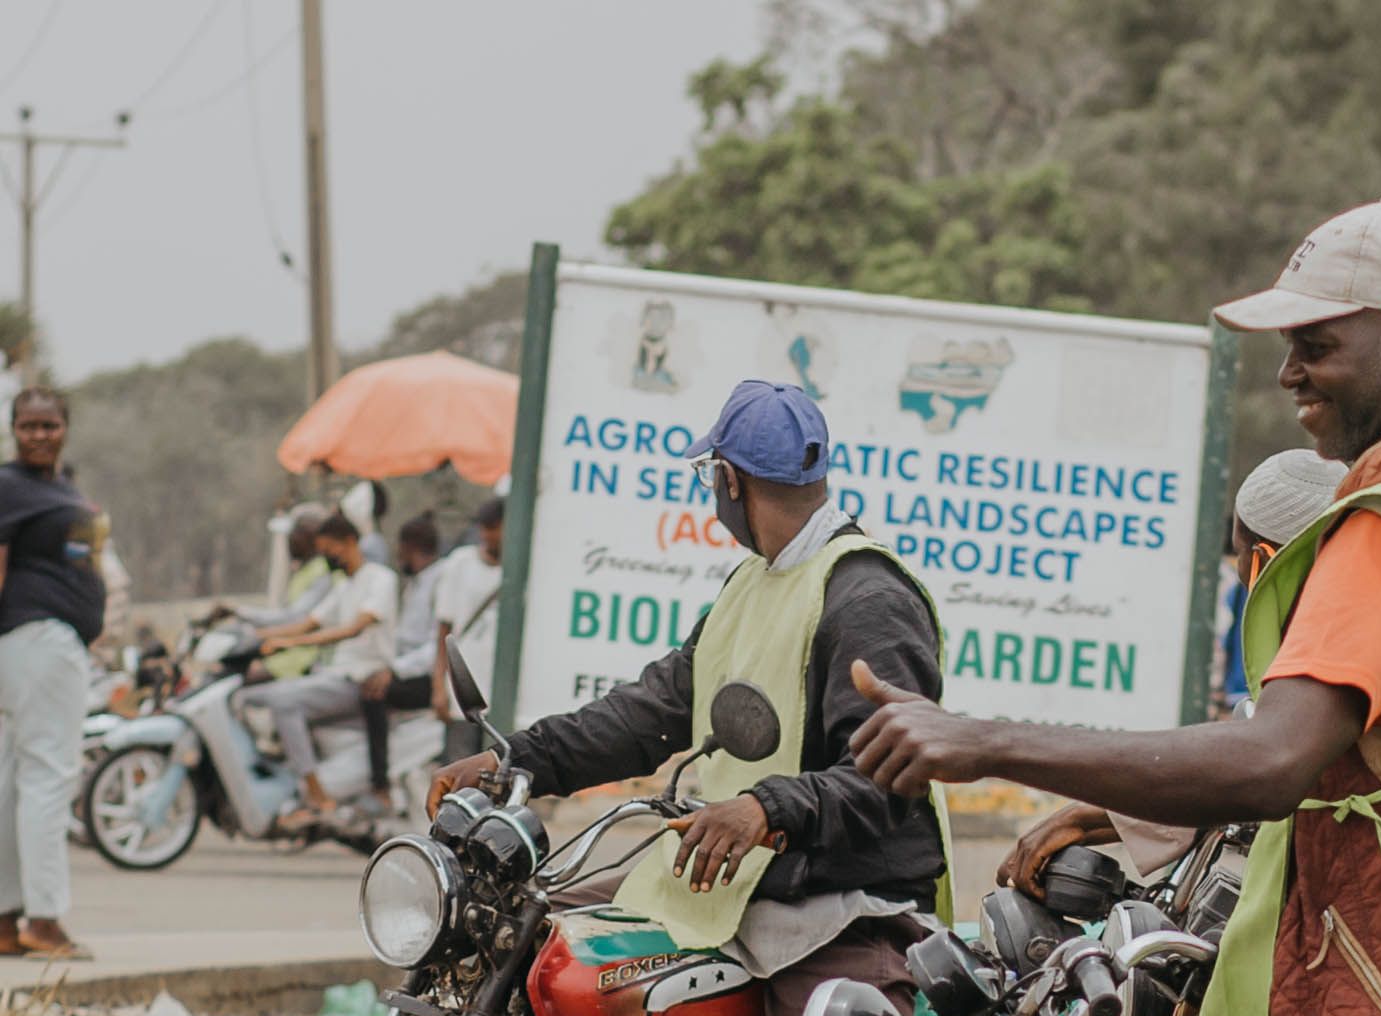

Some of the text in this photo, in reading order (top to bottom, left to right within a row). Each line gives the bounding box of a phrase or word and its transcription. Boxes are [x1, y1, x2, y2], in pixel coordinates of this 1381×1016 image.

[571, 460, 619, 497] IN
[885, 492, 1166, 550] LANDSCAPES
[828, 443, 920, 482] ATIC
[937, 452, 1179, 505] RESILIENCE
[896, 532, 1082, 584] PROJECT
[568, 588, 715, 649] BIOL
[943, 627, 1137, 693] ARDEN
